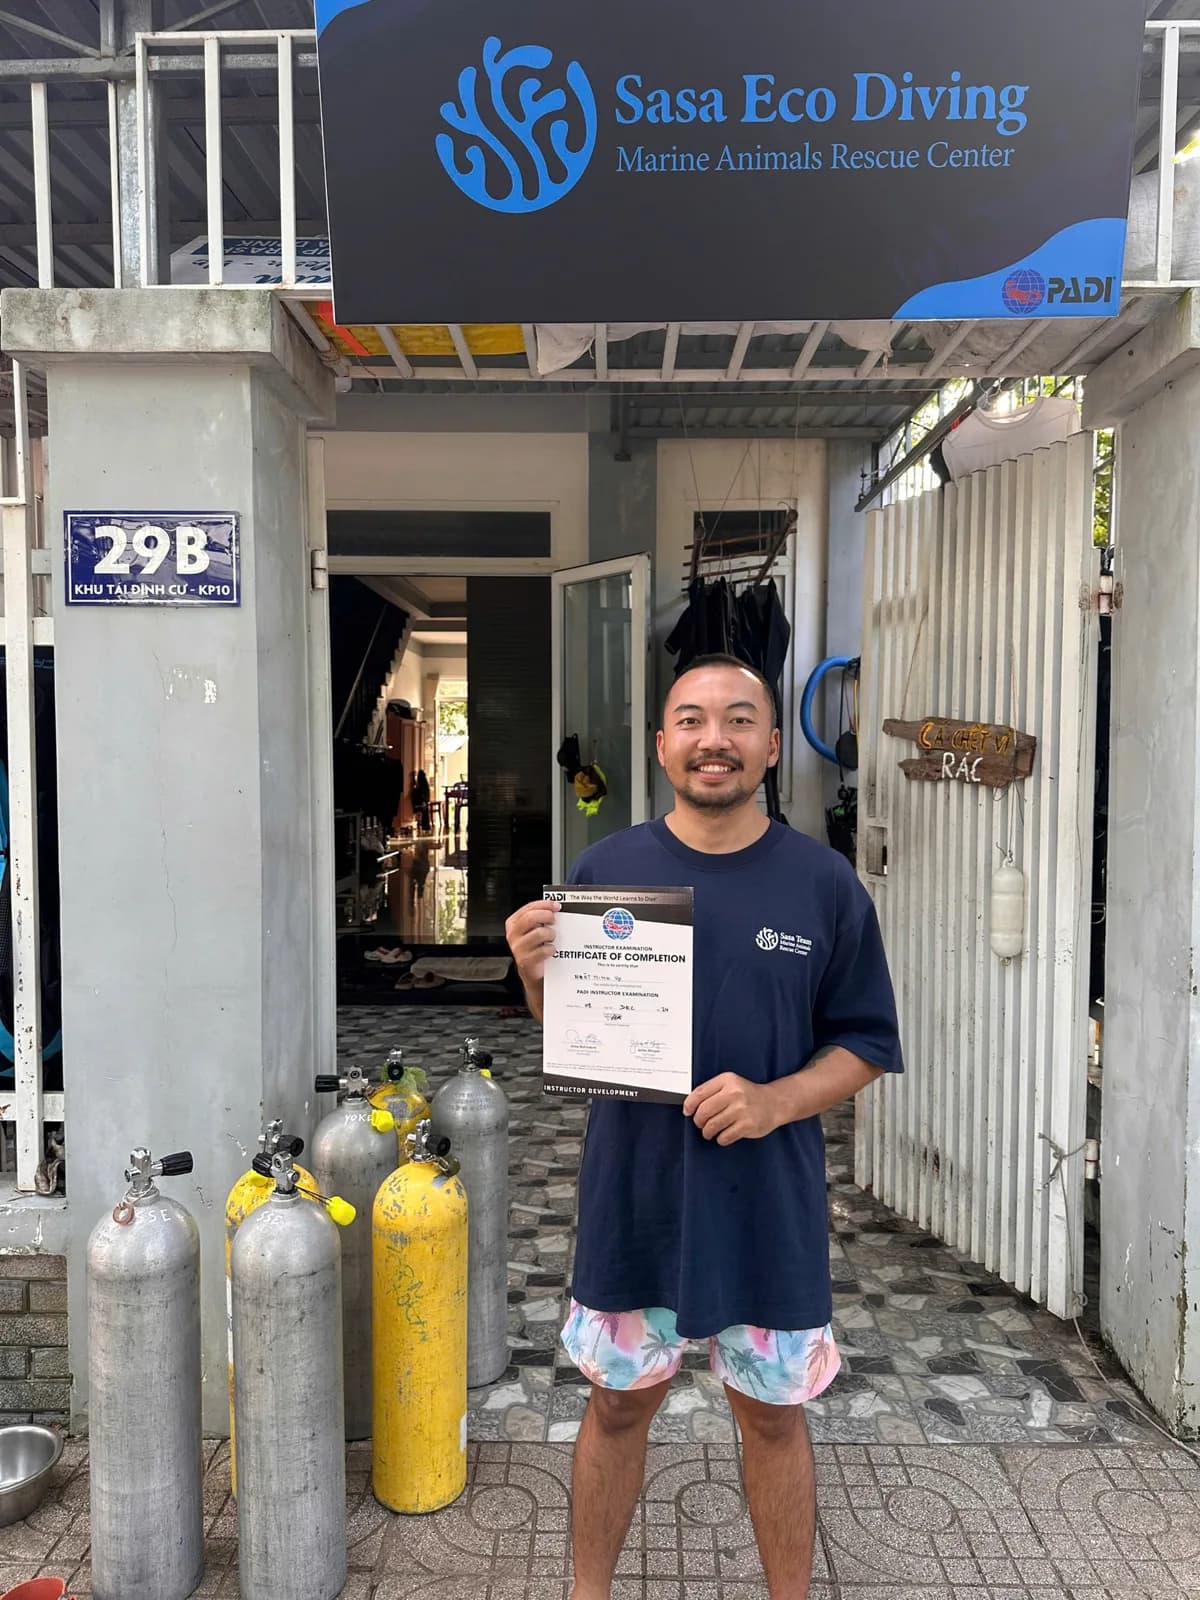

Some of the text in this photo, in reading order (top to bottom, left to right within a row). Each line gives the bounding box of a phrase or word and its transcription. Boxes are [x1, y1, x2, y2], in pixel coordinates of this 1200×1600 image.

[615, 71, 1030, 136] Sasa Eco Diving
[616, 141, 1015, 172] Marine Animals Rescue Center
[1047, 276, 1113, 304] PADI
[94, 525, 210, 575] 29B
[75, 585, 103, 595] KHU
[169, 583, 189, 595] CƯ
[199, 585, 230, 596] KP10
[941, 751, 984, 782] RÁC
[544, 893, 566, 901] PADI
[553, 951, 686, 963] CERTIFICATE OF COMPLETION
[543, 1084, 639, 1098] INSTRUCTOR DEVELOPMENT
